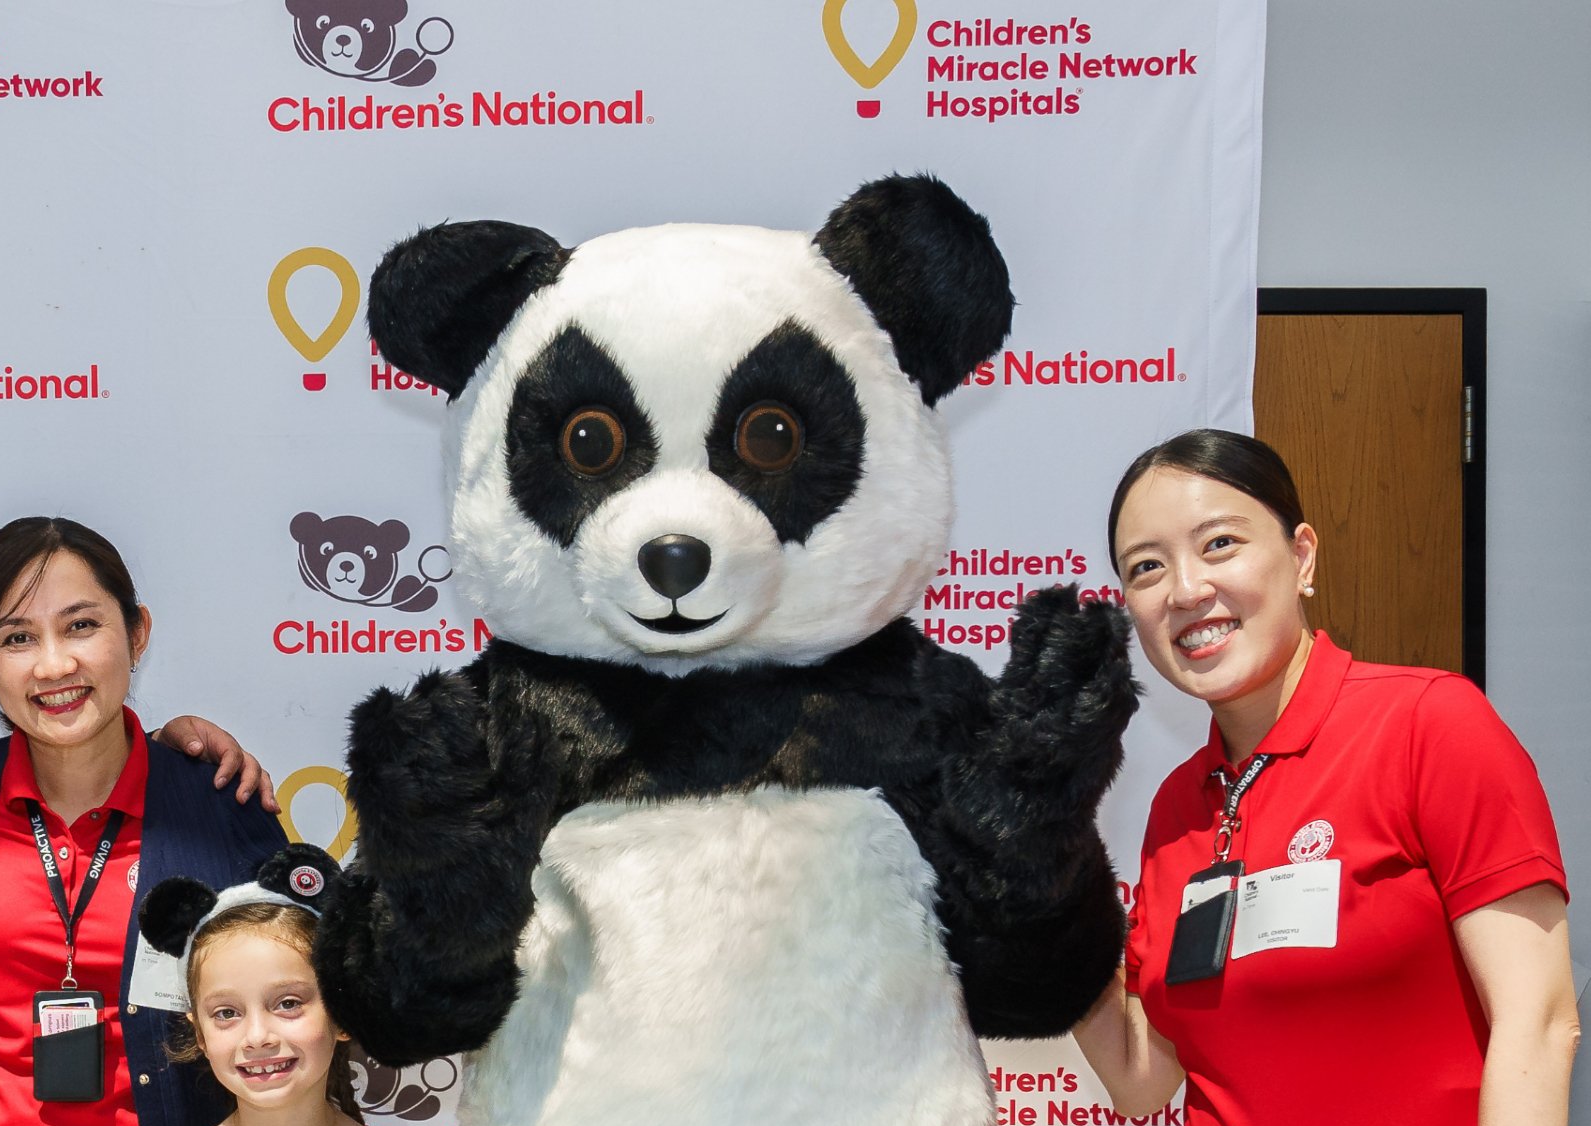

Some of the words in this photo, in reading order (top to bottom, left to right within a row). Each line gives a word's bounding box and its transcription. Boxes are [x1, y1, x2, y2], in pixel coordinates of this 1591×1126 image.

[926, 17, 1091, 48] Children's
[927, 52, 1049, 83] Miracle
[1058, 48, 1197, 80] Network
[267, 92, 465, 133] Children's
[472, 89, 644, 127] National
[926, 87, 1080, 123] Hospitals
[1004, 346, 1176, 386] National
[923, 582, 1040, 611] Miracl
[272, 618, 466, 655] Children's
[31, 814, 58, 878] PROACTIVE
[89, 840, 111, 879] GIVING
[988, 1065, 1079, 1094] dren's
